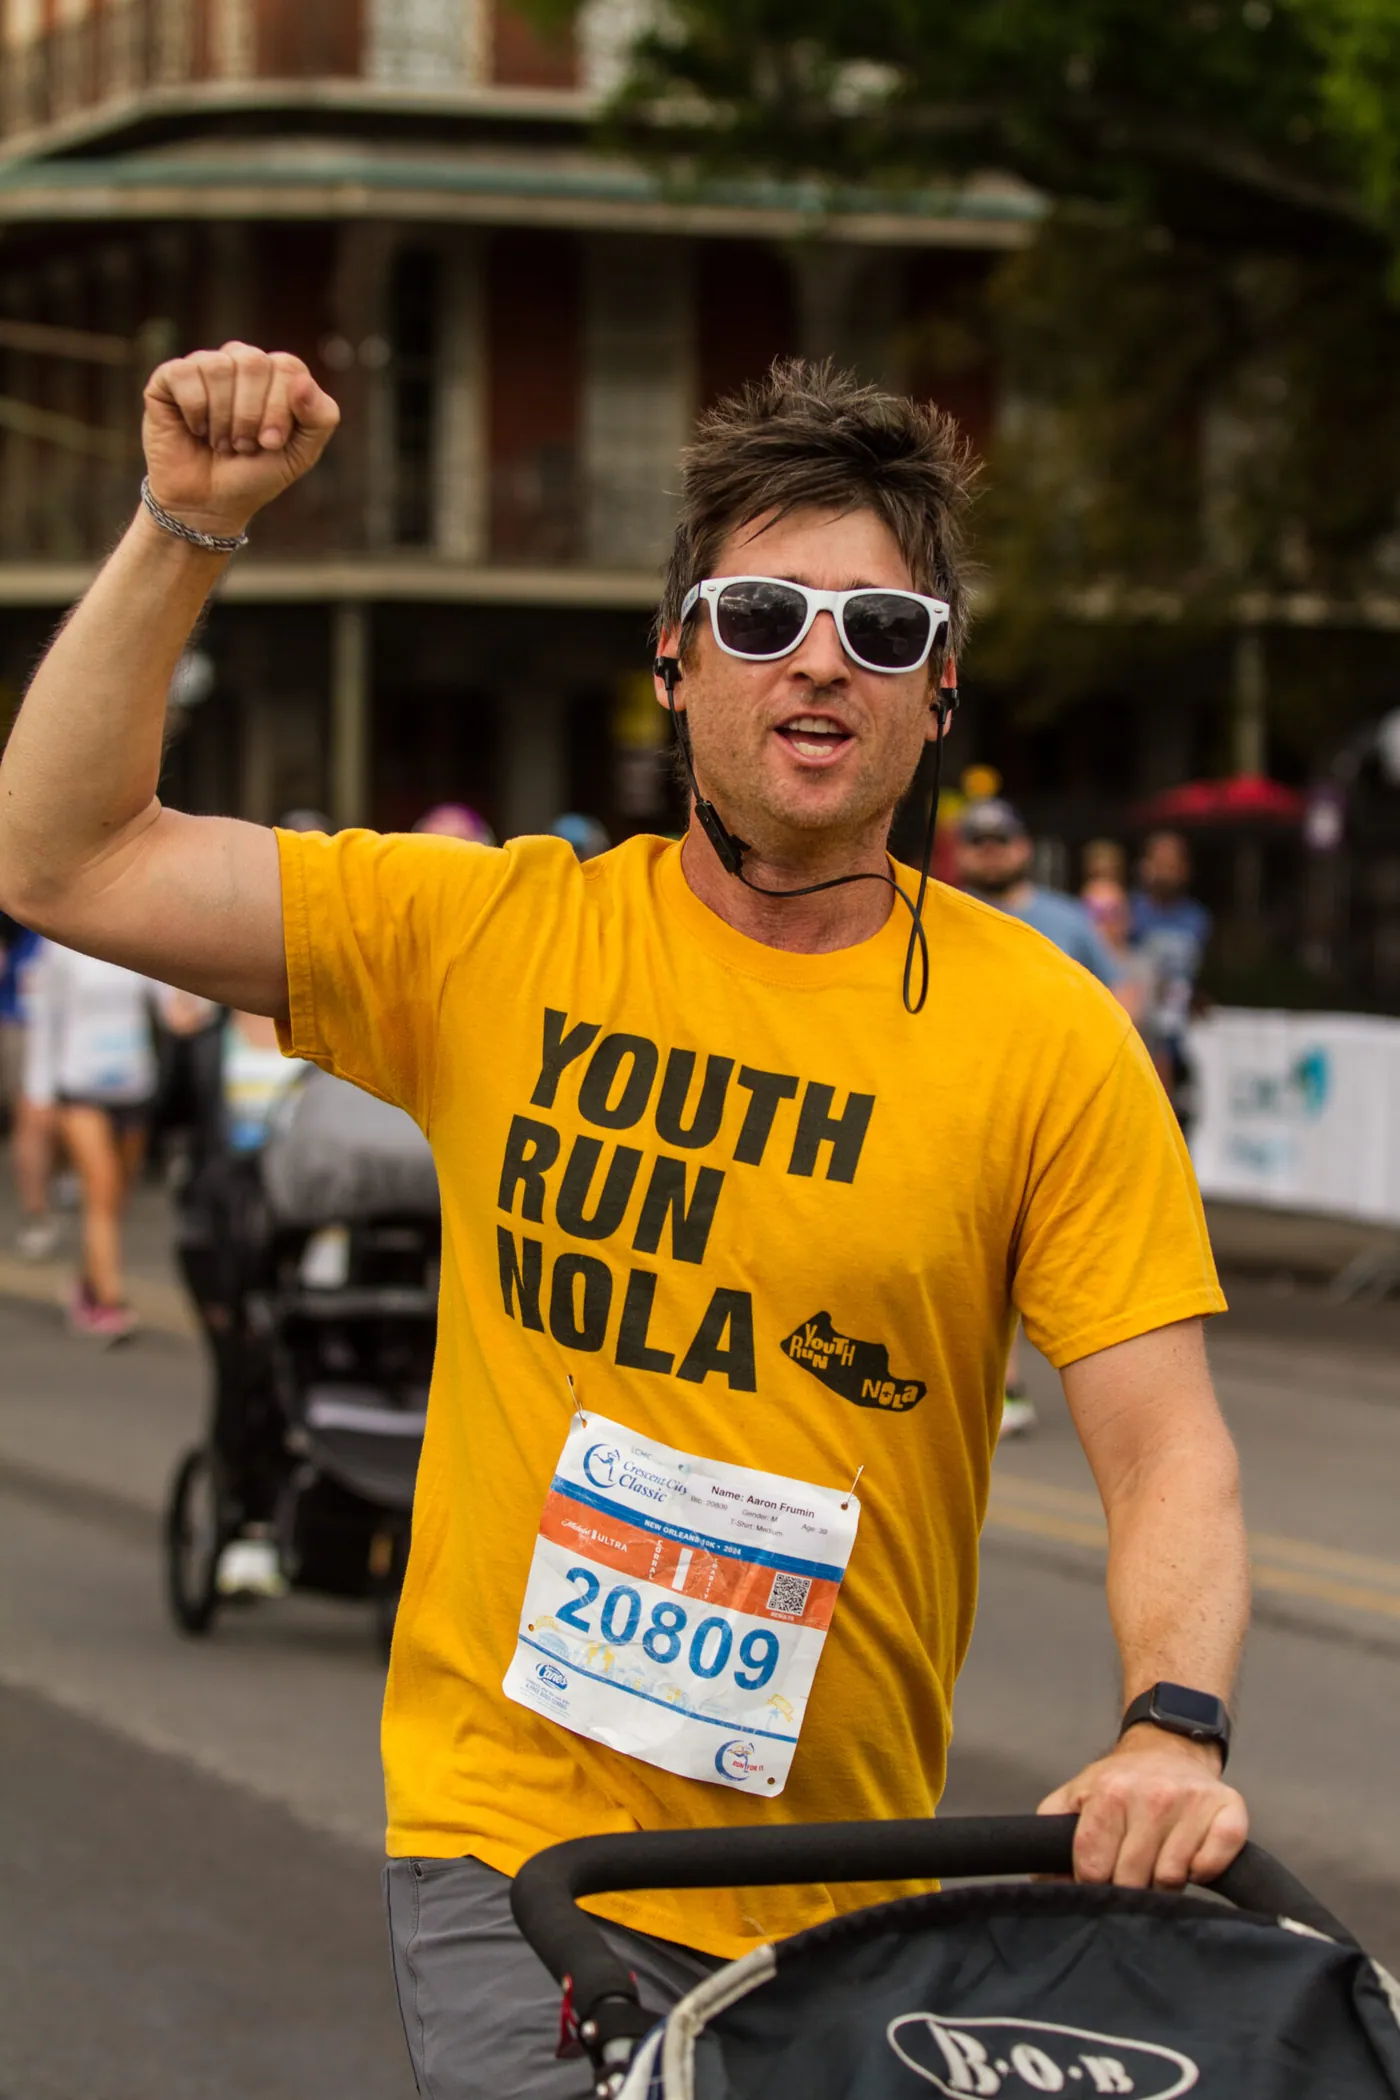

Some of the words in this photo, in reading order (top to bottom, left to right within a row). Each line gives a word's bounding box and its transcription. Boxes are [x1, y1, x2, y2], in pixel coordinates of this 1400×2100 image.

[529, 1006, 876, 1185] YOUTH
[497, 1113, 726, 1265] RUN
[496, 1224, 757, 1393] NOLA
[619, 1474, 667, 1502] Classic
[623, 1461, 666, 1487] Crescent
[666, 1479, 688, 1495] City
[711, 1485, 745, 1501] Name:
[747, 1495, 777, 1510] Aaron
[780, 1503, 815, 1519] Frumin
[742, 1508, 770, 1521] Gender:
[770, 1515, 778, 1523] M
[597, 1535, 628, 1552] ULTRA
[644, 1519, 662, 1532] NEW
[663, 1526, 699, 1543] ORLEANS
[701, 1539, 716, 1549] 10K
[723, 1544, 742, 1555] 2024
[756, 1524, 783, 1537] Medium
[649, 1540, 664, 1580] CORRAL
[555, 1566, 780, 1692] 20809
[732, 1760, 744, 1769] RUN
[747, 1764, 758, 1772] FOR
